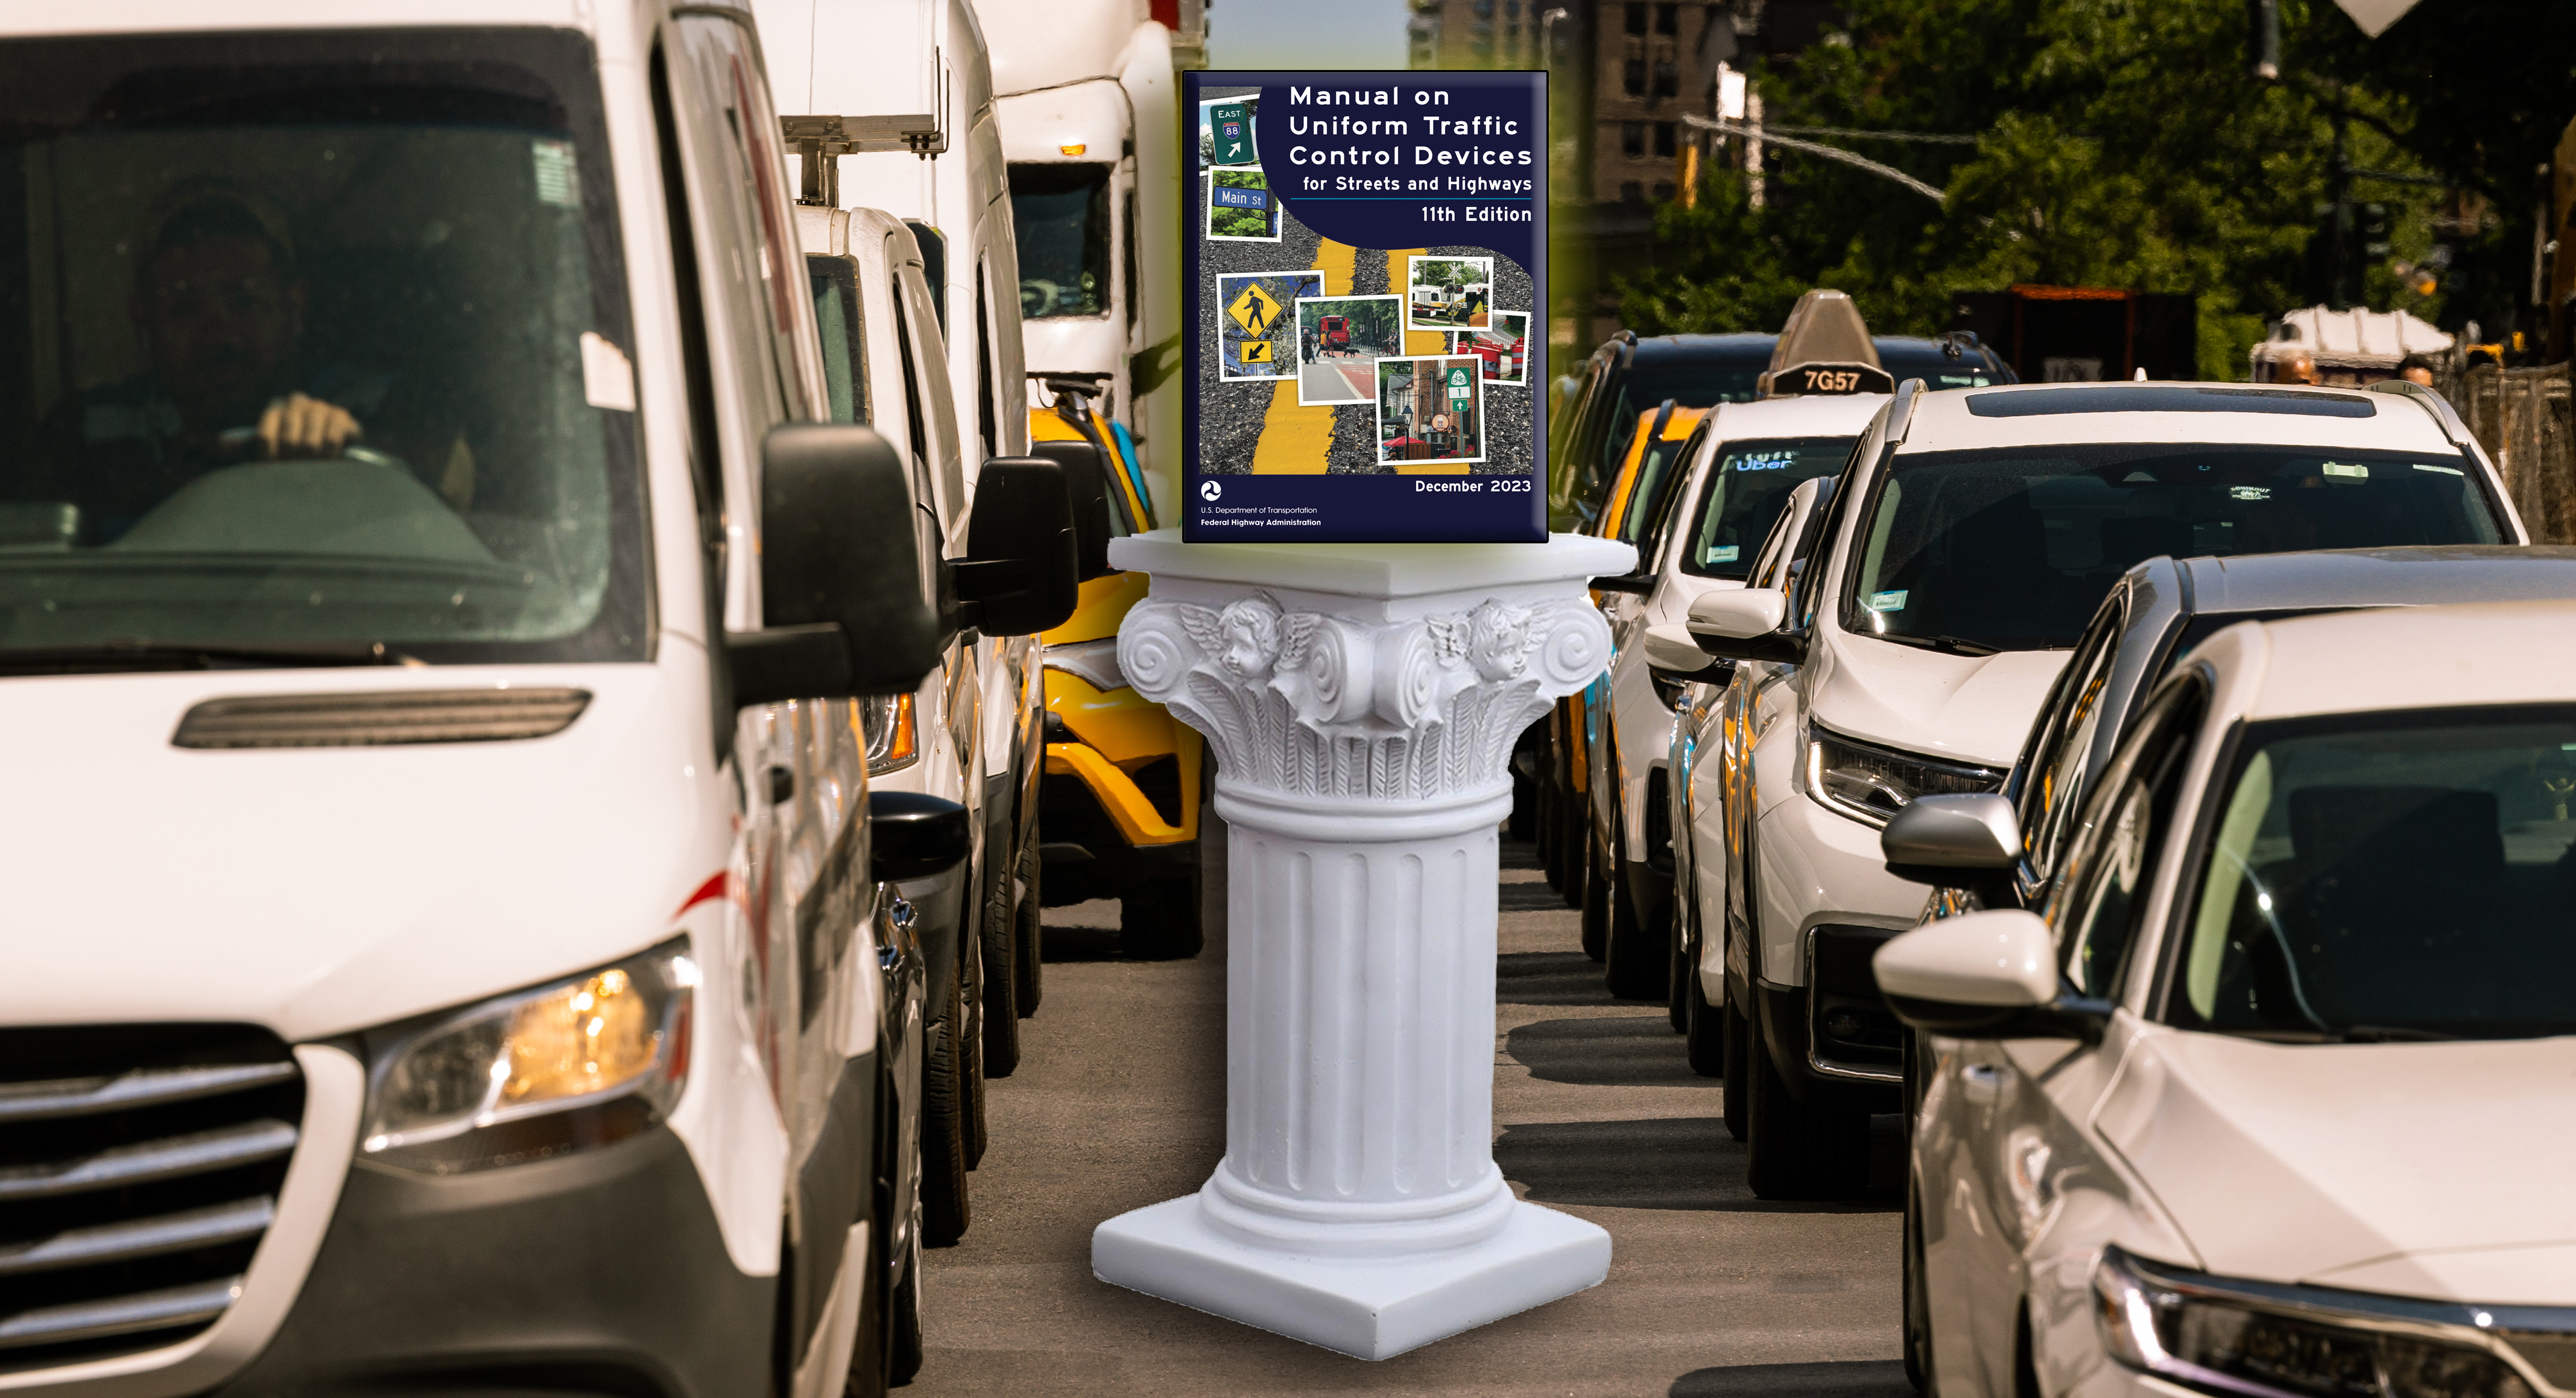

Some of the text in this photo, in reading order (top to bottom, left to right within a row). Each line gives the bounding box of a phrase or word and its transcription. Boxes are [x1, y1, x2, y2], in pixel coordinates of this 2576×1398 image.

[1291, 86, 1449, 106] Manual on
[1226, 127, 1238, 135] 88
[1290, 116, 1517, 135] Uniform Traffic
[1290, 145, 1532, 165] Control Devices
[1303, 176, 1532, 195] for Streets and Highways
[1222, 191, 1261, 205] Main St
[1422, 206, 1532, 221] 11th Edition
[1805, 370, 1861, 391] 7G57
[1458, 388, 1461, 397] 1
[1737, 460, 1792, 471] Uber
[1416, 480, 1531, 492] December 2023
[1215, 507, 1258, 515] Department
[1267, 507, 1317, 515] Transportation
[1231, 519, 1264, 527] Highway
